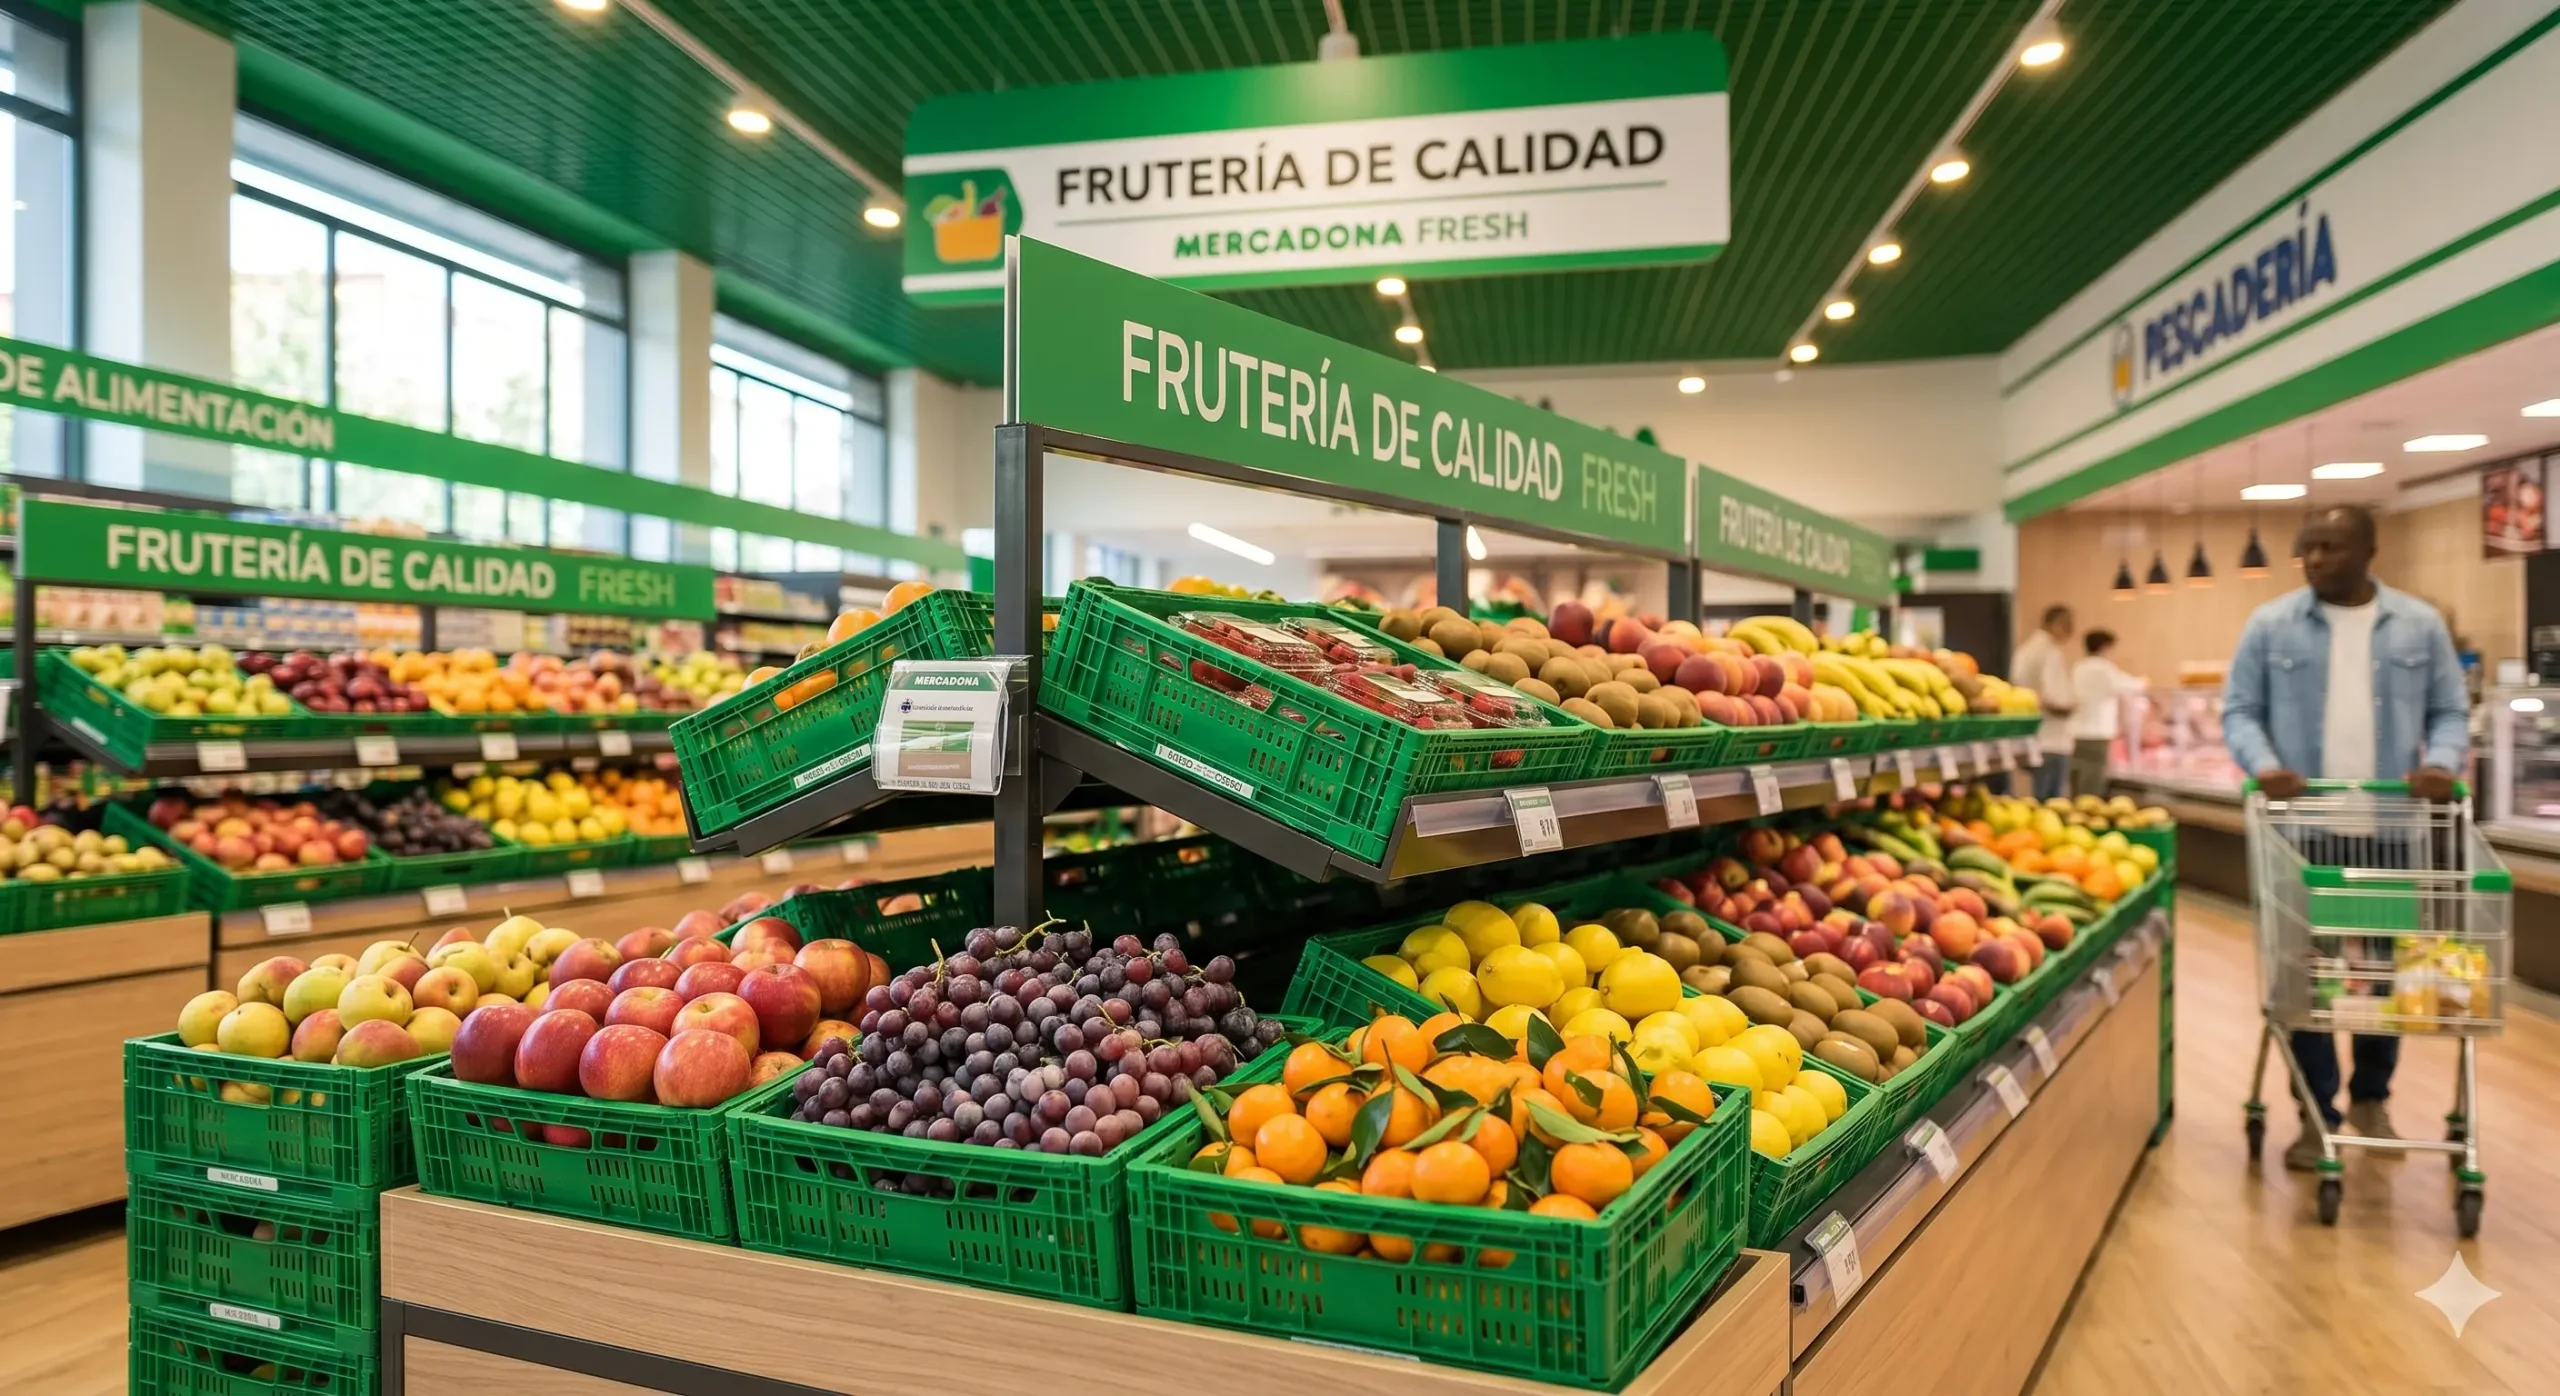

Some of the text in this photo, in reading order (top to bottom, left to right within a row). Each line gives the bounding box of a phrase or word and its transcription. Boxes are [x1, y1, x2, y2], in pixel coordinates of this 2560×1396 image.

[1056, 124, 1667, 207] FRUTERÍA DE CALIDAD
[1174, 212, 1530, 258] MERCADONA FRESH
[2144, 198, 2337, 381] PESCADERÍA
[54, 363, 335, 452] ALIMENTACIÓN
[1122, 319, 1658, 526] FRUTERÍA DE CALIDAD FRESH
[107, 524, 676, 608] FRUTERÍA DE CALIDAD FRESH
[914, 676, 980, 686] MERCADONA
